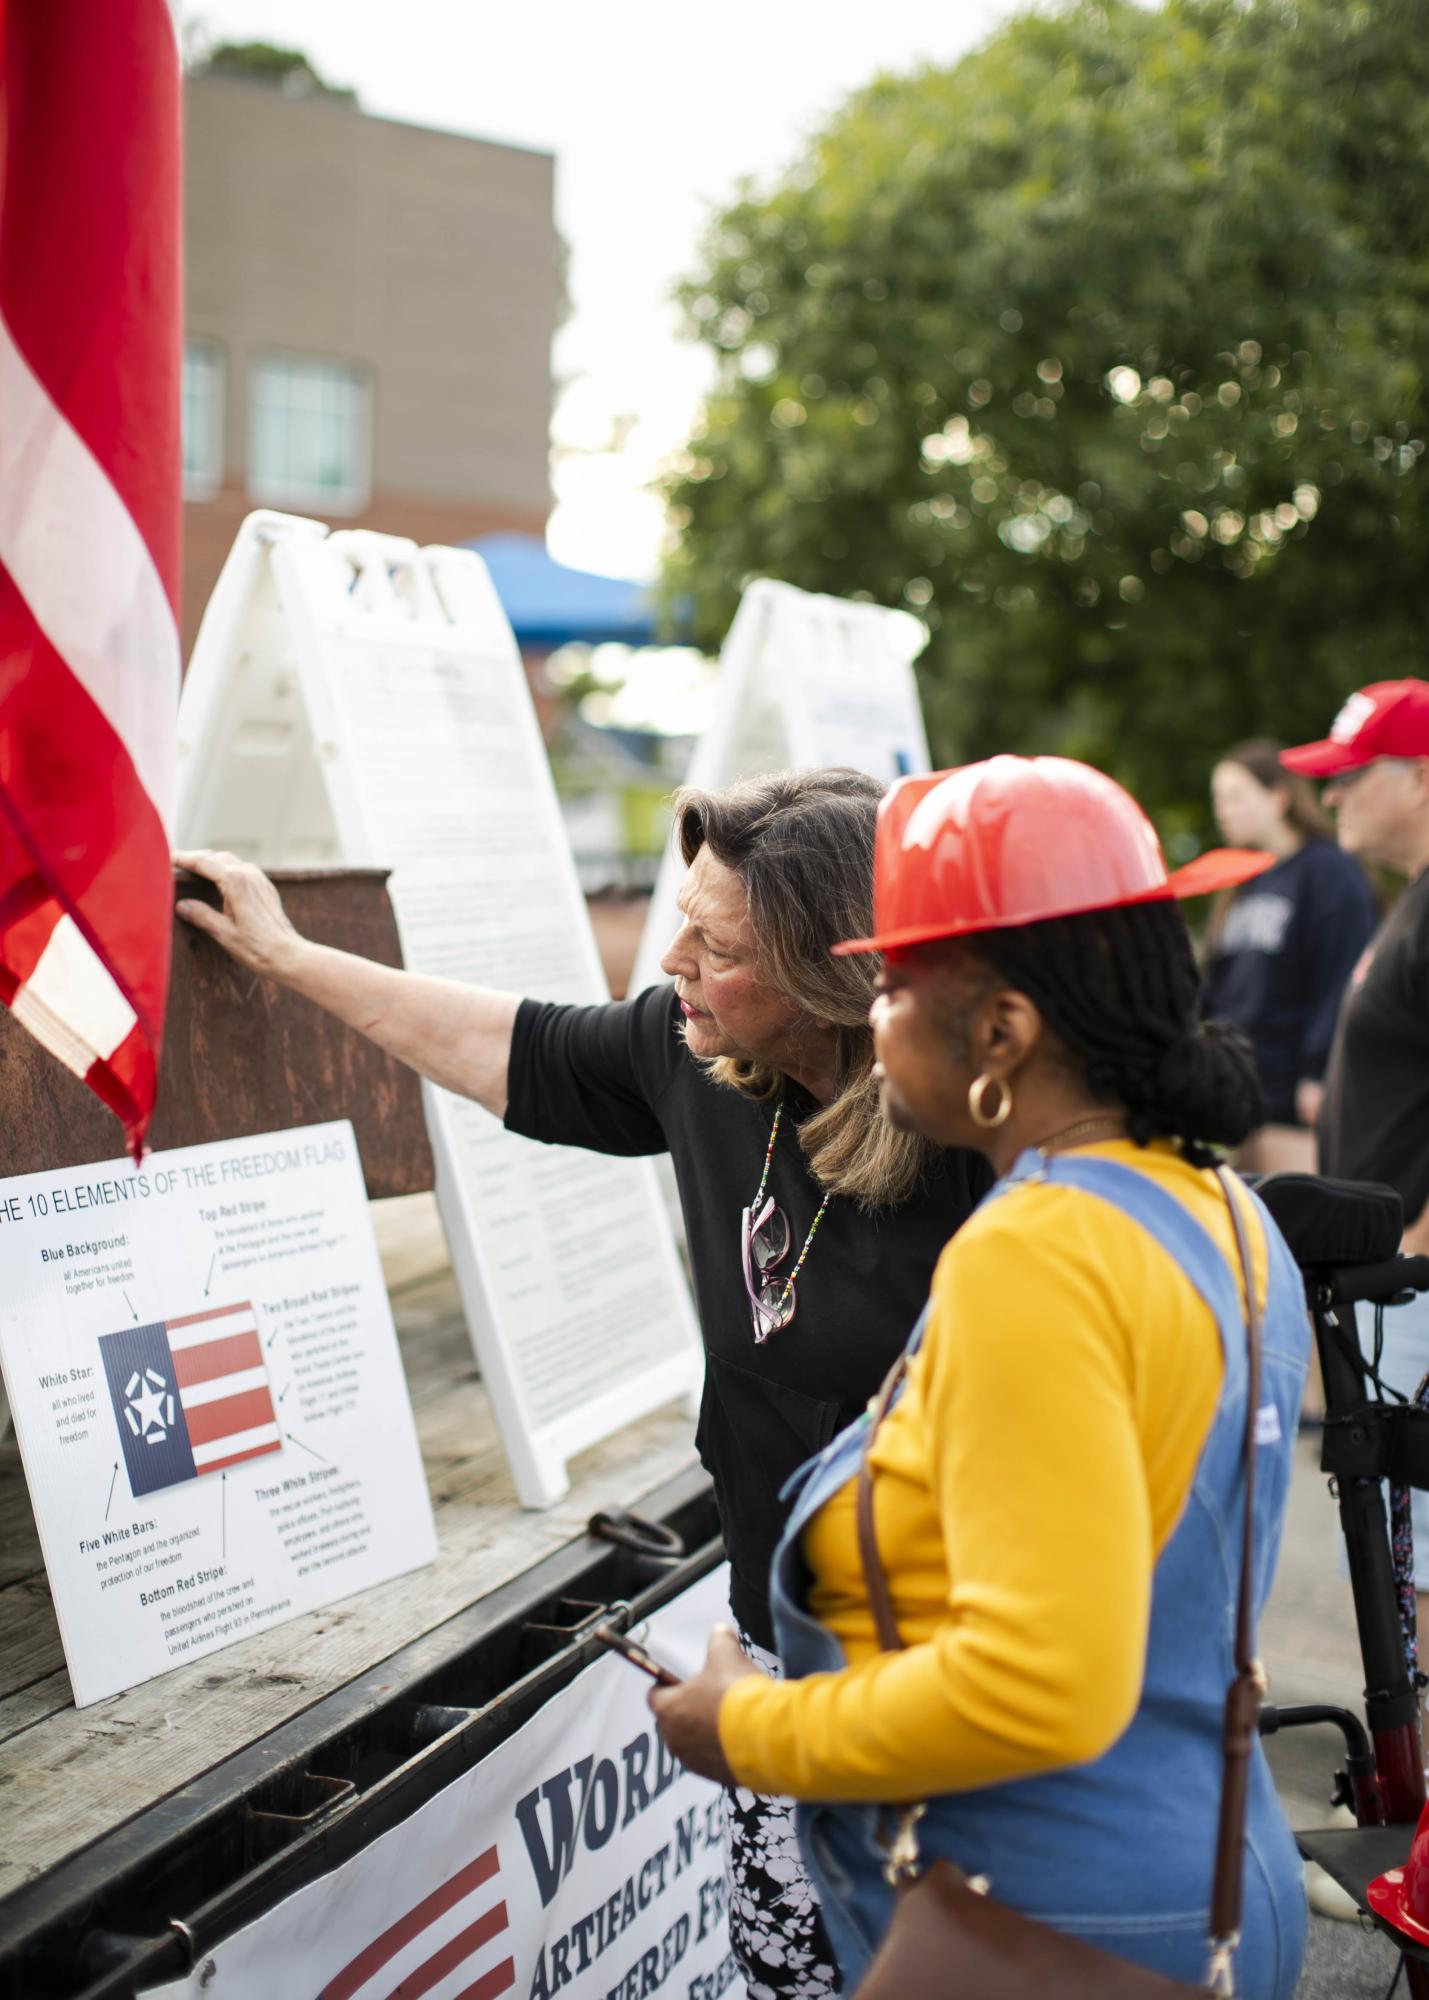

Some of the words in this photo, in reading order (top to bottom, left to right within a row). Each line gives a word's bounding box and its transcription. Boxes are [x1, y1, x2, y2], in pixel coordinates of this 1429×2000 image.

[0, 1197, 24, 1223] HE
[28, 1193, 48, 1217] 10
[52, 1175, 150, 1213] ELEMENTS
[154, 1169, 177, 1195] OF
[181, 1163, 217, 1188] THE
[220, 1149, 301, 1182] FREEDOM
[302, 1140, 346, 1166] FLAG
[41, 1248, 64, 1262] Blue
[66, 1234, 130, 1257] Background:
[64, 1270, 72, 1281] all
[73, 1264, 110, 1279] Americans
[111, 1258, 132, 1271] united
[38, 1373, 68, 1389] White
[69, 1368, 94, 1381] Star:
[52, 1399, 61, 1411] all
[62, 1396, 77, 1408] who
[77, 1390, 95, 1403] lived
[56, 1415, 70, 1428] and
[70, 1410, 86, 1424] died
[86, 1408, 97, 1418] for
[59, 1430, 89, 1445] freedom
[79, 1539, 100, 1554] Five
[102, 1529, 130, 1545] White
[132, 1520, 158, 1536] Bars:
[96, 1561, 108, 1572] the
[108, 1549, 141, 1567] Pentagon
[143, 1542, 155, 1555] and
[156, 1539, 168, 1549] the
[169, 1526, 200, 1546] organized
[100, 1570, 134, 1591] protection
[135, 1564, 142, 1576] of
[143, 1562, 154, 1573] our
[155, 1553, 182, 1568] freedom
[140, 1585, 175, 1606] Bottom
[176, 1575, 196, 1592] Red
[196, 1566, 228, 1584] Stripe:
[160, 1612, 171, 1622] the
[172, 1597, 206, 1617] bloodshed
[206, 1592, 214, 1604] of
[213, 1590, 225, 1600] the
[226, 1585, 240, 1595] crew
[242, 1576, 255, 1590] and
[164, 1617, 202, 1640] passengers
[203, 1612, 216, 1622] who
[217, 1599, 244, 1619] perished
[245, 1597, 253, 1605] on
[168, 1639, 190, 1655] United
[191, 1630, 214, 1646] Airlines
[214, 1622, 233, 1636] Flight
[233, 1617, 242, 1628] 93
[243, 1616, 250, 1624] in
[250, 1599, 291, 1620] Pennsylvania
[515, 1720, 686, 1909] WORL
[530, 1843, 670, 2000] ARTIFACT
